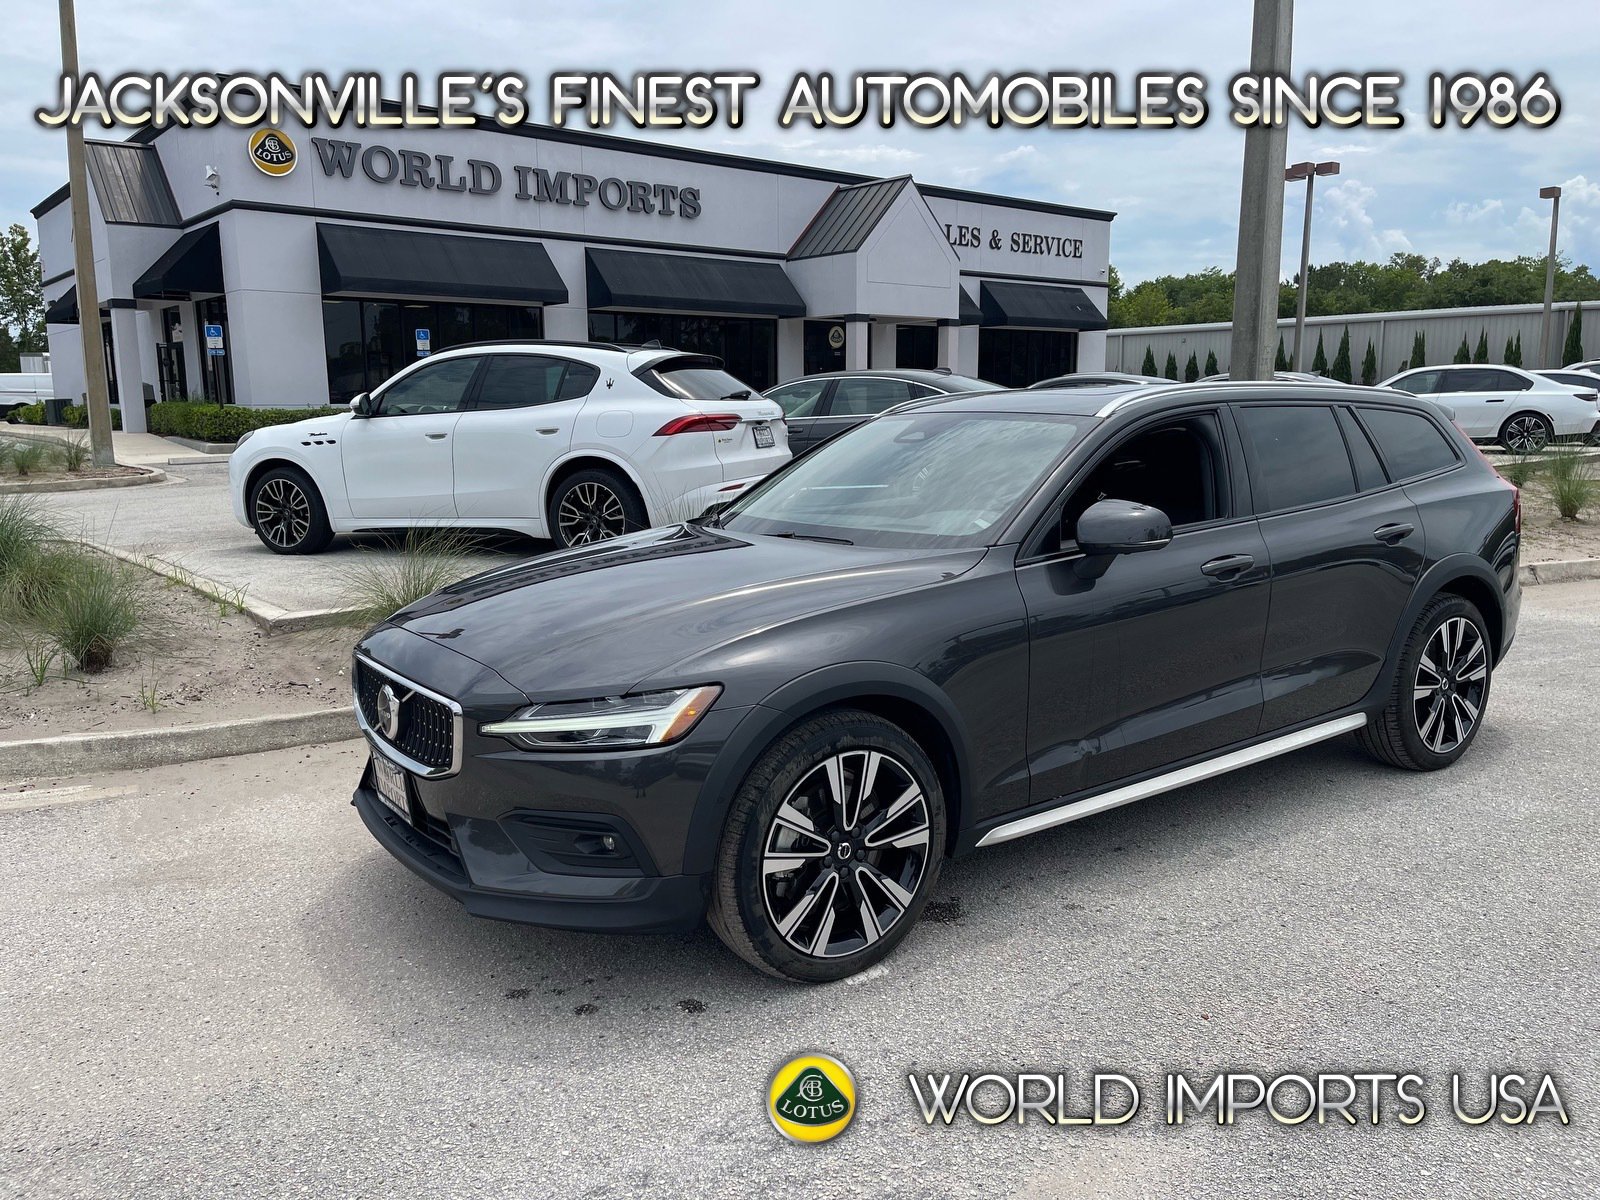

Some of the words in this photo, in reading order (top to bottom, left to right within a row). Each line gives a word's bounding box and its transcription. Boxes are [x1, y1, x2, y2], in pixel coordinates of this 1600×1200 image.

[256, 148, 292, 162] LOTUS
[311, 137, 502, 195] WORLD
[514, 165, 702, 218] IMPORTS
[988, 229, 1002, 251] &
[1010, 232, 1083, 259] SERVICE
